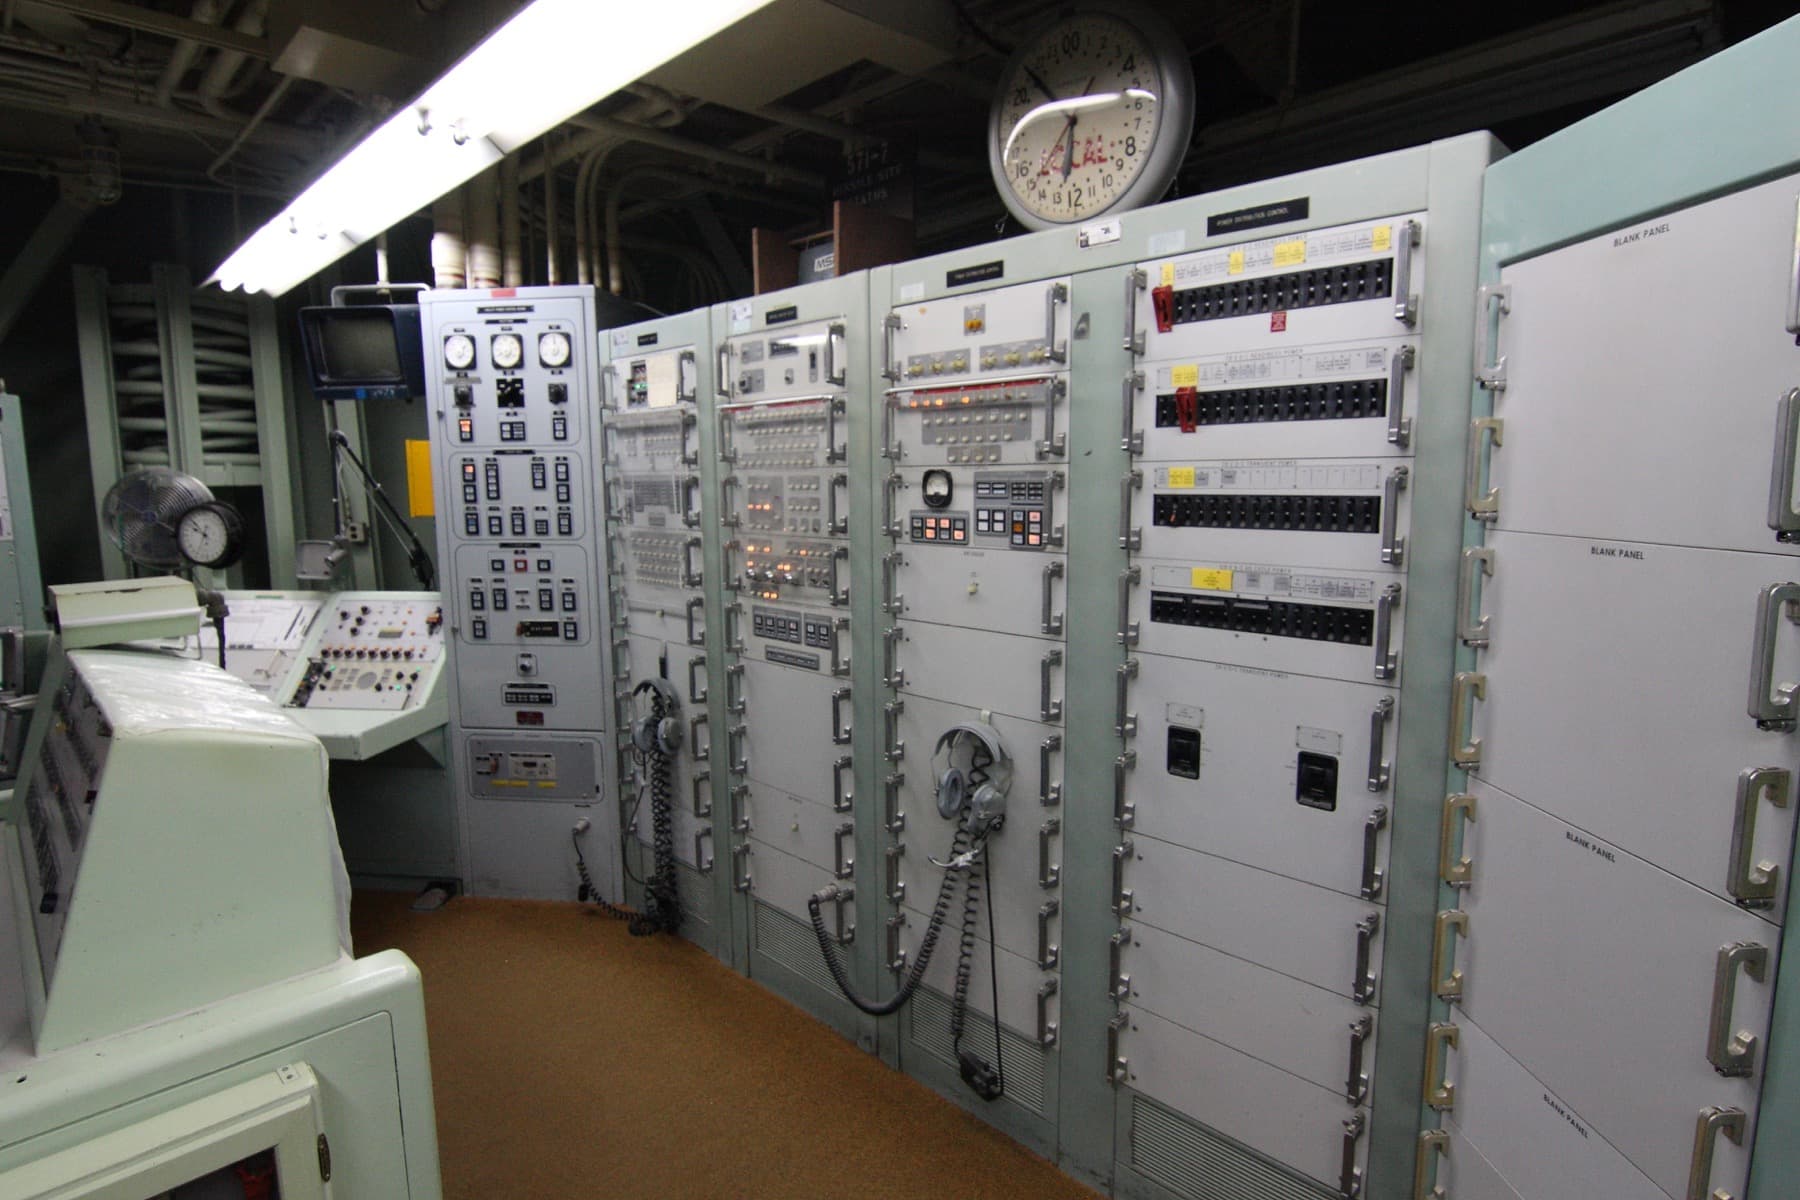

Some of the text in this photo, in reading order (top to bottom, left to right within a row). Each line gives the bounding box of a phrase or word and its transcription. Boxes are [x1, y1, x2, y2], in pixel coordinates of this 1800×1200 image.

[1062, 31, 1080, 53] 00
[1123, 53, 1136, 72] 4
[1132, 78, 1141, 90] 5
[1013, 87, 1028, 106] 20
[1135, 98, 1144, 110] 6
[1135, 117, 1142, 131] 7
[1125, 136, 1136, 156] 8
[1016, 161, 1029, 179] 16
[1115, 158, 1125, 172] 9
[1026, 179, 1037, 191] 15
[1102, 174, 1113, 188] 10
[1038, 189, 1047, 200] 14
[1053, 191, 1062, 204] 13
[1068, 188, 1082, 208] 12
[1088, 185, 1096, 198] 11
[1613, 223, 1671, 247] BLANK PANEL
[1591, 546, 1646, 560] BLANK PANEL
[1566, 831, 1615, 863] BLANK PANEL
[1543, 1093, 1588, 1139] BLANK PANEL
